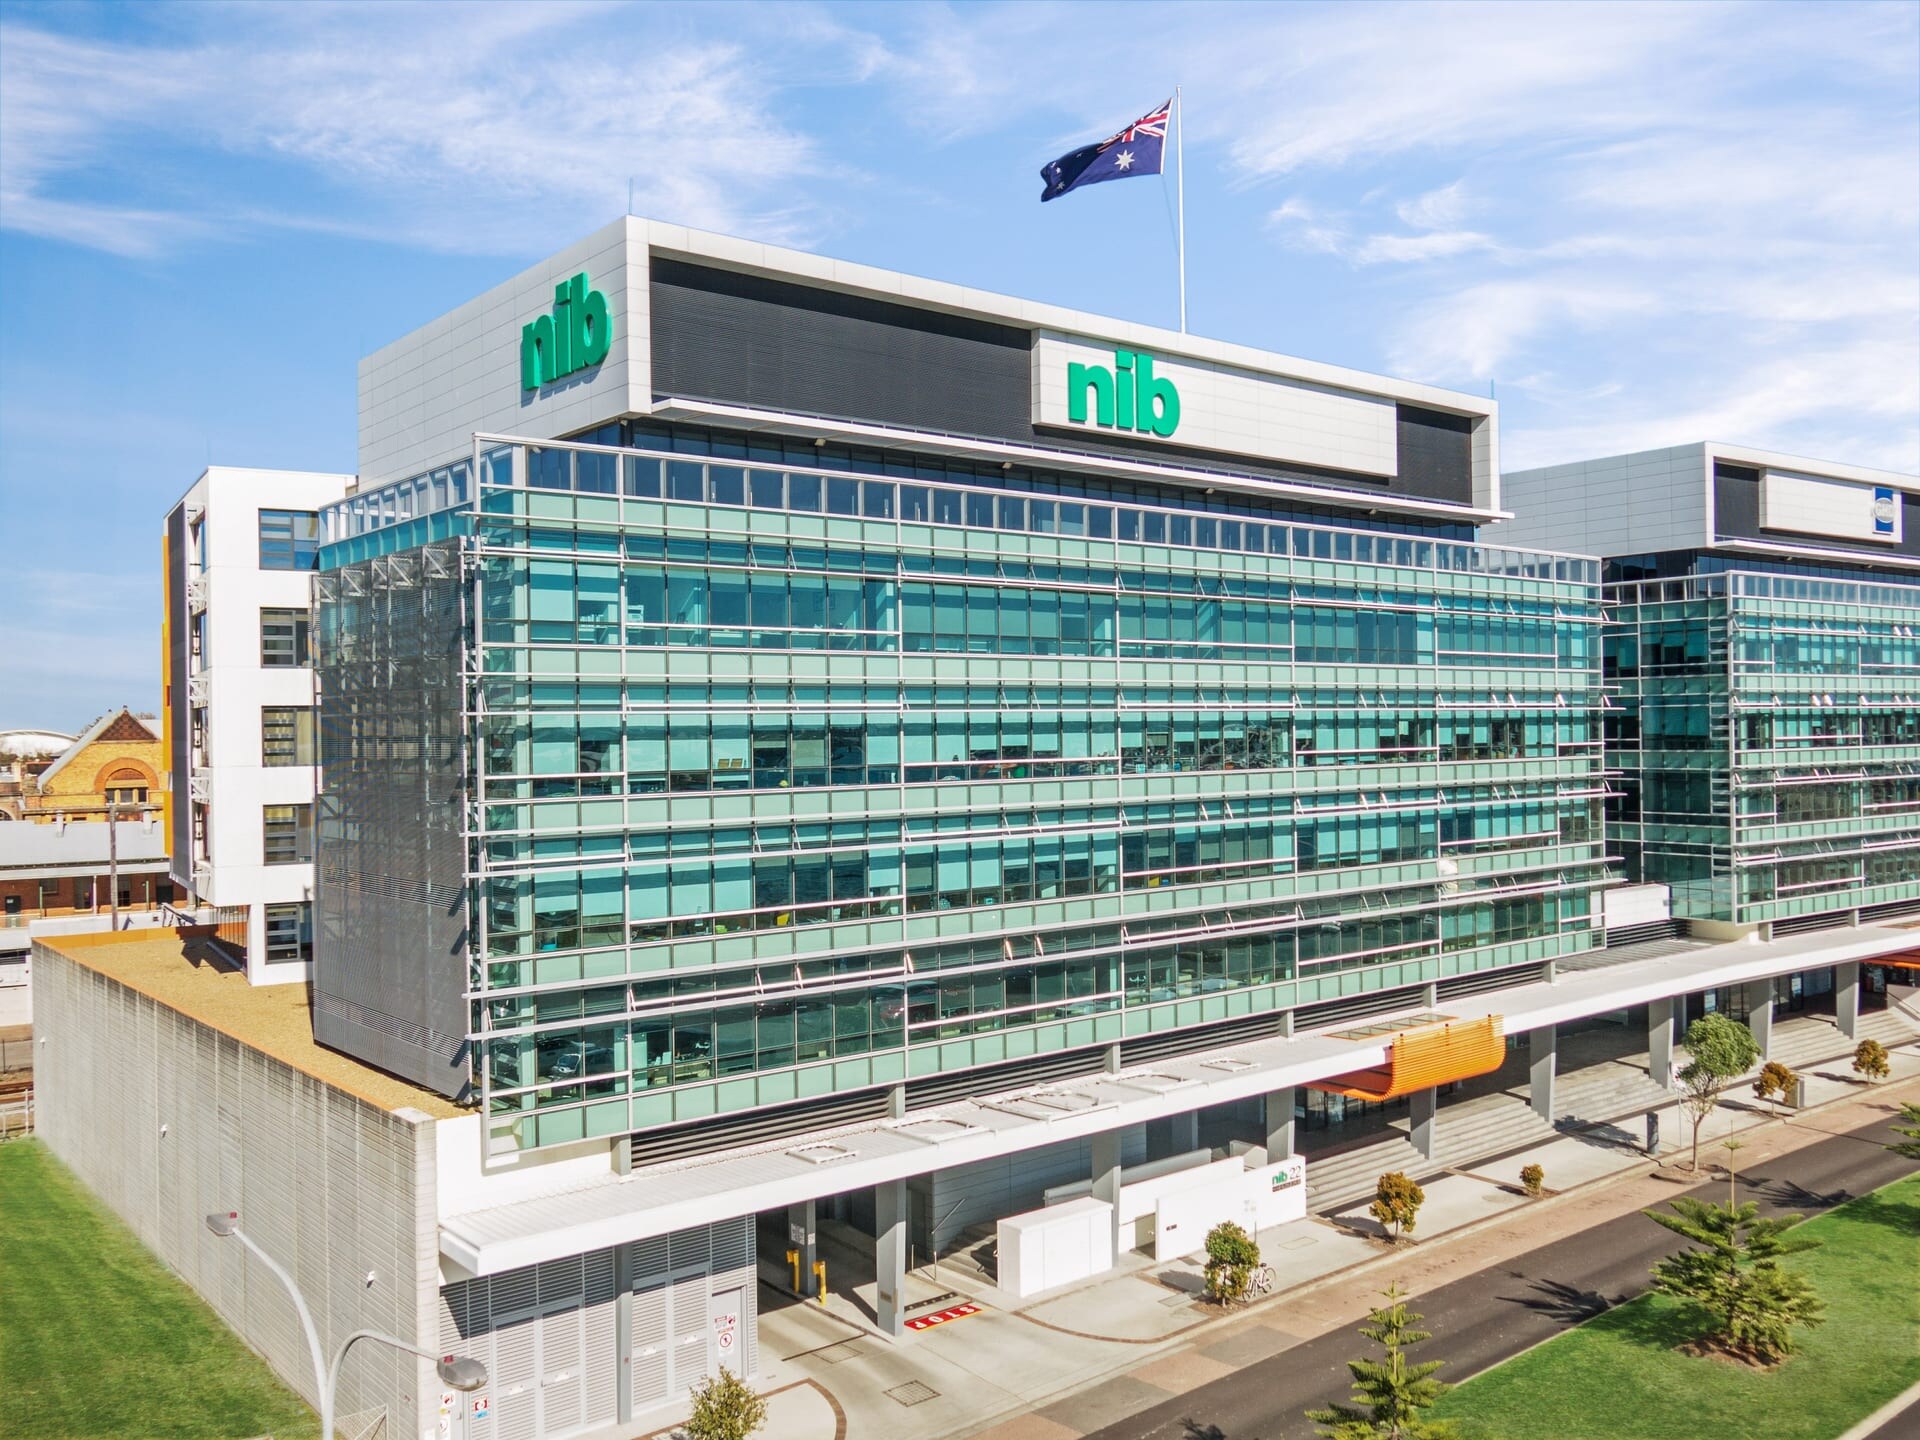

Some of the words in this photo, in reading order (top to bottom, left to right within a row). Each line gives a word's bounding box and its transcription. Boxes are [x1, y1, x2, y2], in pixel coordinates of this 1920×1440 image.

[521, 272, 613, 391] nib
[1067, 349, 1180, 437] nib
[1272, 1170, 1288, 1185] nib
[1289, 1165, 1301, 1180] 22
[914, 1306, 975, 1328] STOP
